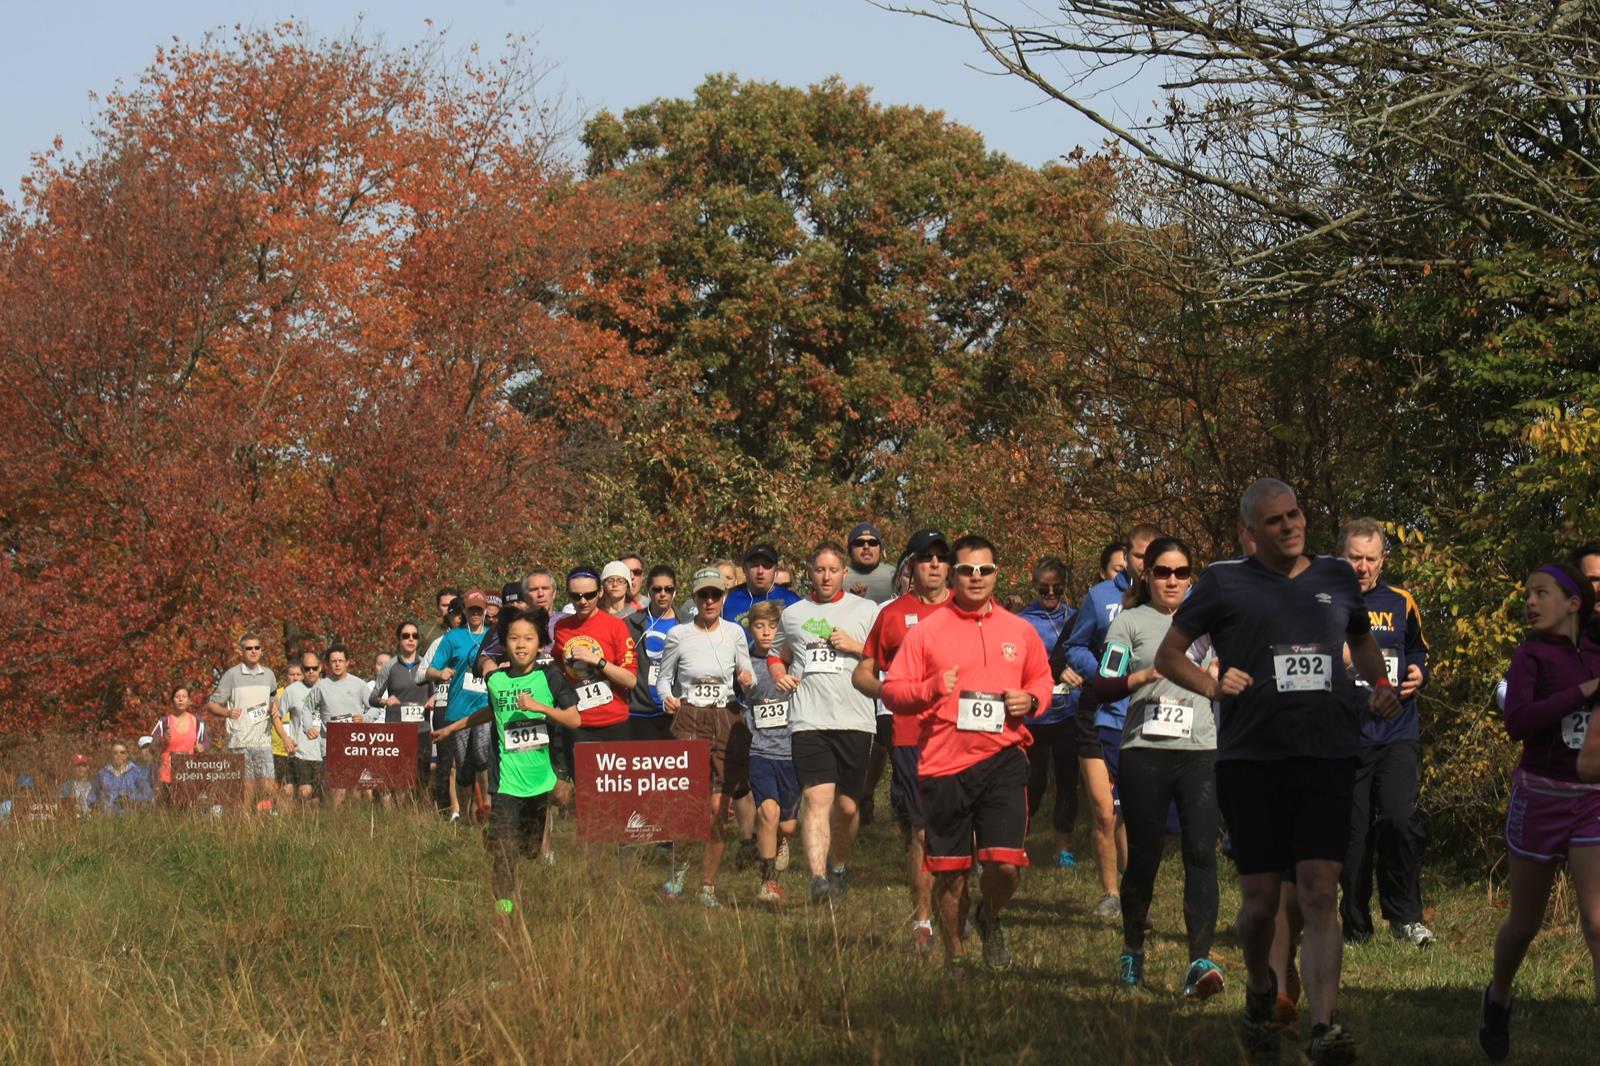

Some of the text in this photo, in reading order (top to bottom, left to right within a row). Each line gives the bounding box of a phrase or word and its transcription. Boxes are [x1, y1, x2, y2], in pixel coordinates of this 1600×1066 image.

[812, 650, 837, 662] 139
[1285, 656, 1324, 675] 292
[584, 684, 602, 699] 14
[695, 685, 720, 698] 335
[252, 707, 266, 718] 266
[405, 707, 421, 715] 123
[760, 704, 785, 719] 233
[972, 702, 993, 718] 69
[350, 732, 394, 745] so you
[511, 727, 539, 744] 301
[344, 746, 400, 757] can race
[185, 759, 230, 771] through
[596, 751, 689, 771] We saved
[175, 770, 241, 782] open space!
[595, 773, 690, 796] this place
